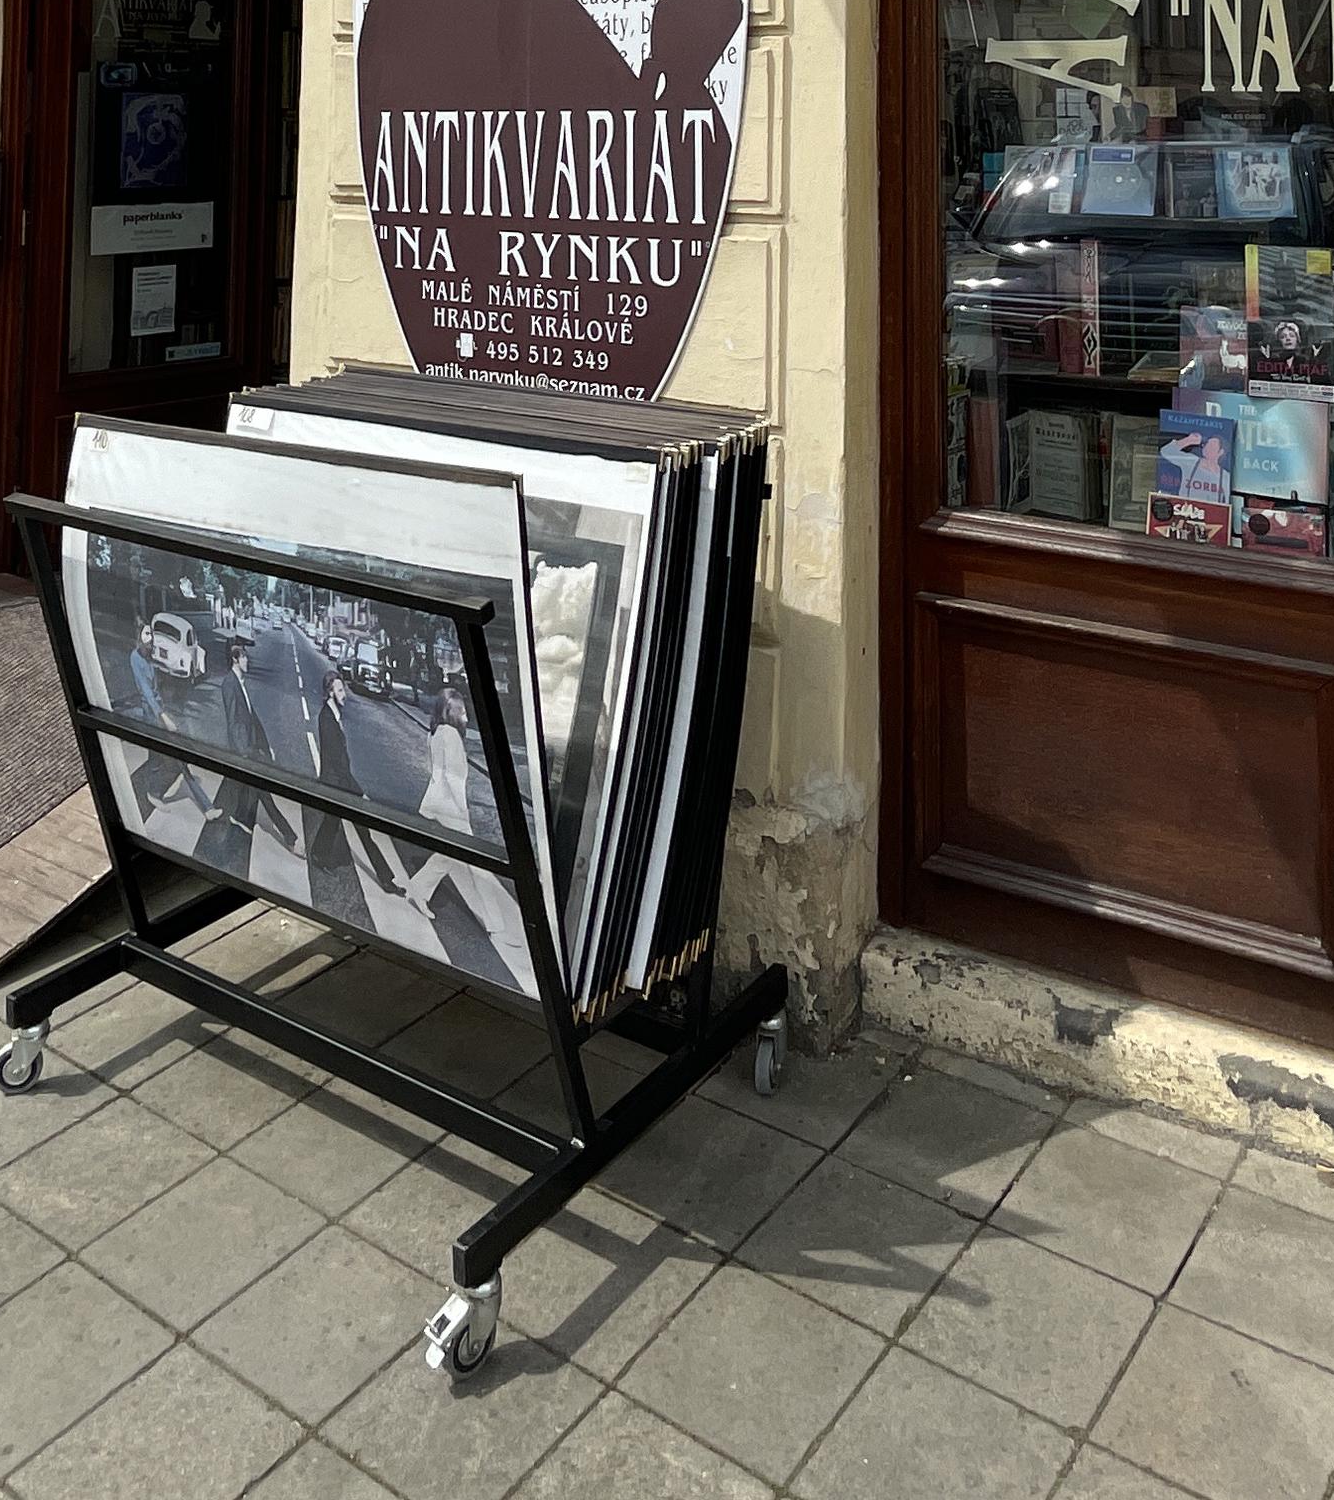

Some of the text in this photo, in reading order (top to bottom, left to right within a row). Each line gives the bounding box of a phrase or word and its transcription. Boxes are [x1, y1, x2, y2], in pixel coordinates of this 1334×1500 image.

[370, 72, 717, 225] ANTIKVARIÁT
[123, 210, 183, 226] paperblanks
[379, 225, 703, 288] "NA RYNKU"
[421, 277, 649, 318] MALÉ NÁMĚSTÍ 129
[433, 306, 634, 346] HRADEC KRÁLOVÉ
[485, 341, 610, 372] 495 512 349
[1243, 457, 1279, 473] BACK
